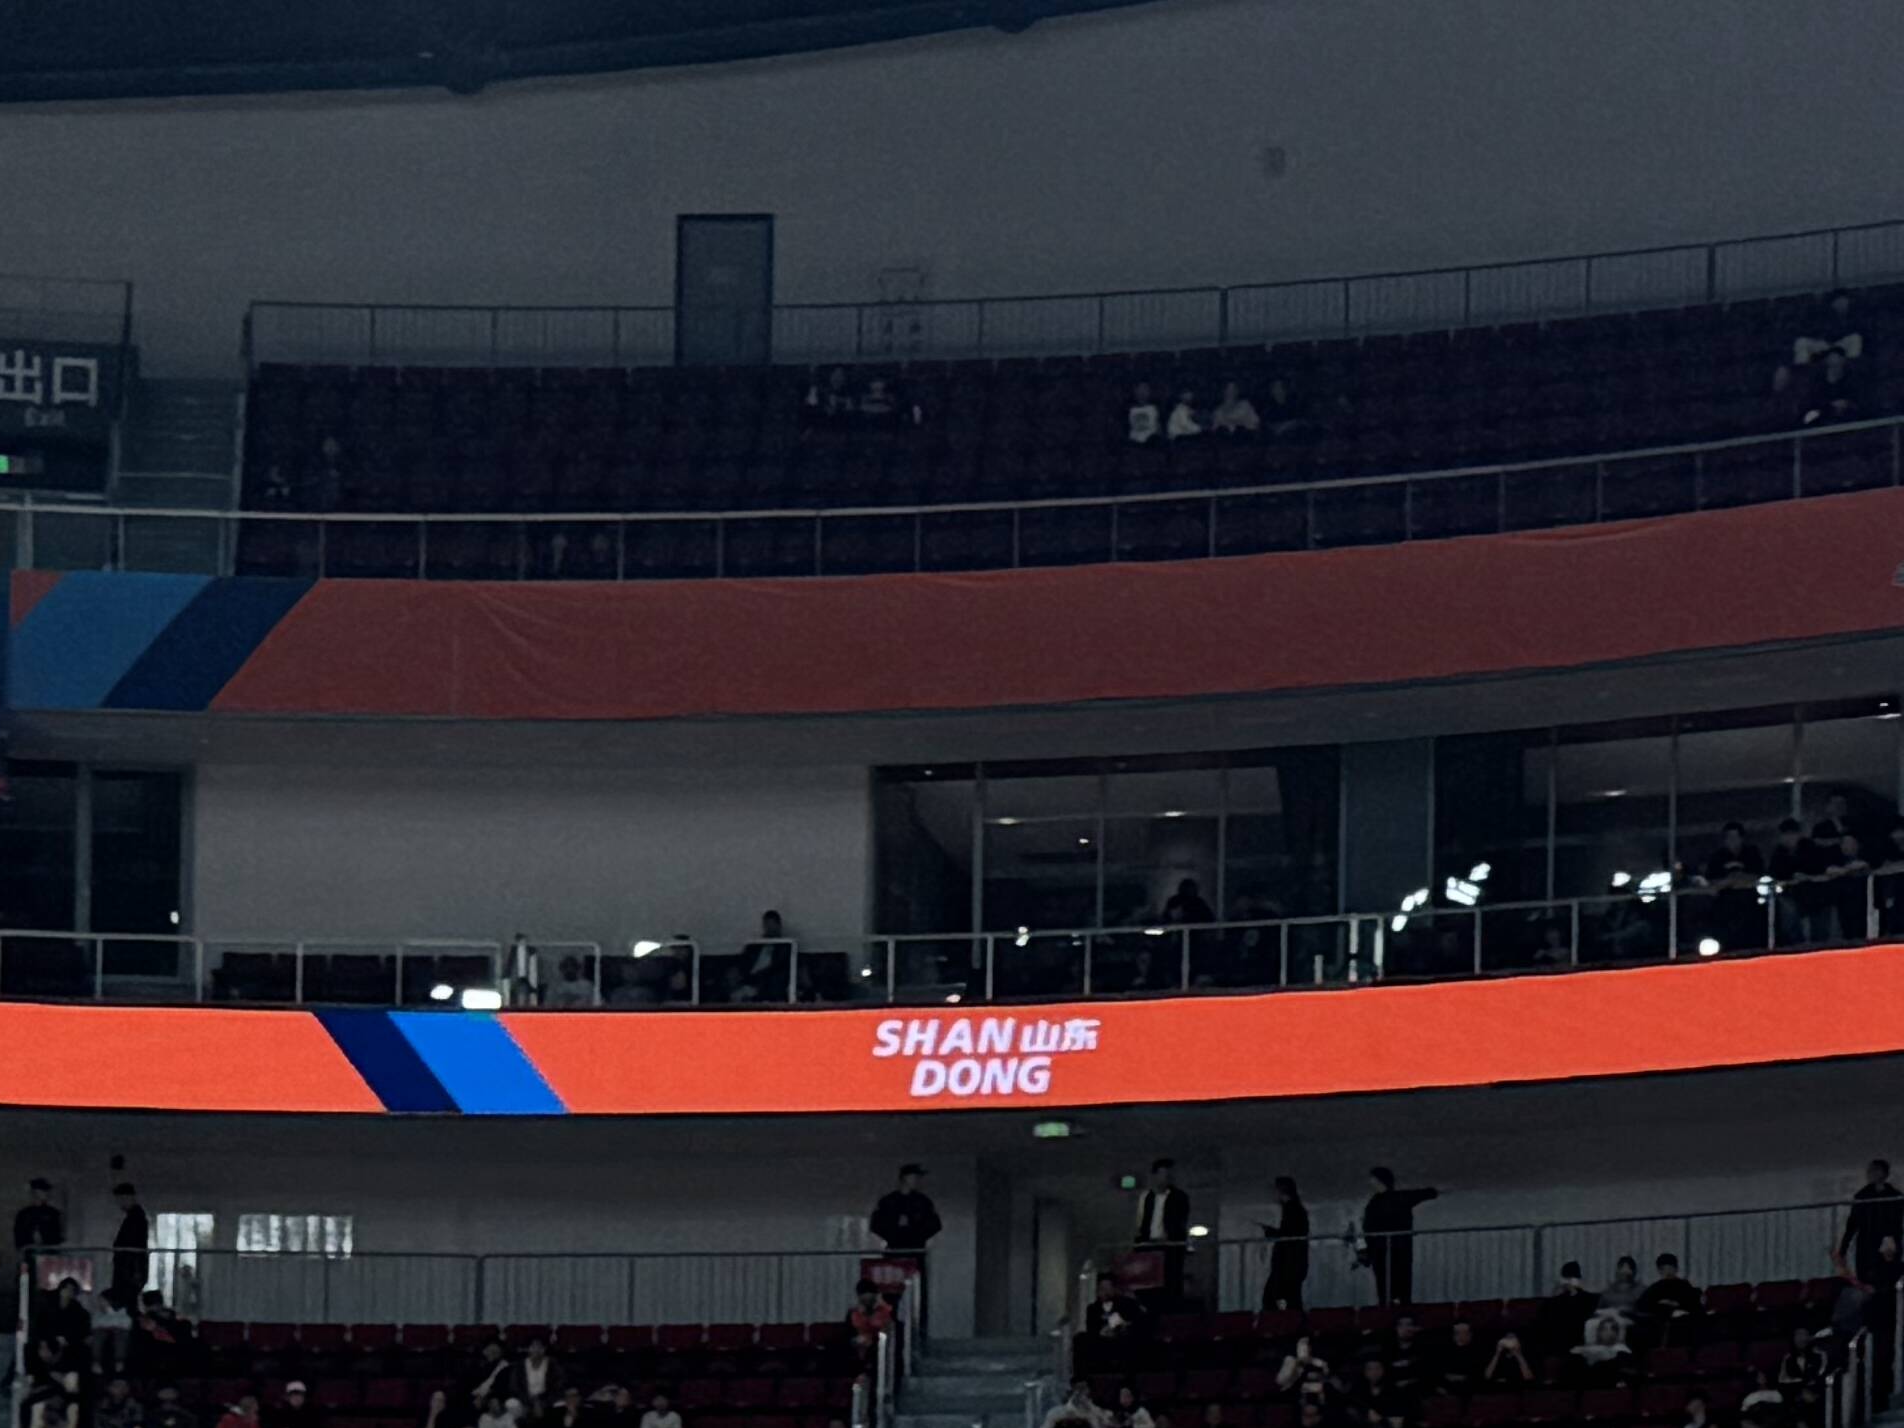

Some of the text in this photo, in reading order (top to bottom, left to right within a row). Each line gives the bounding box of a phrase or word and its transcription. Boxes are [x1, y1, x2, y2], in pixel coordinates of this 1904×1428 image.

[871, 1017, 1102, 1057] SHAN 山东
[910, 1056, 1052, 1097] DONG
